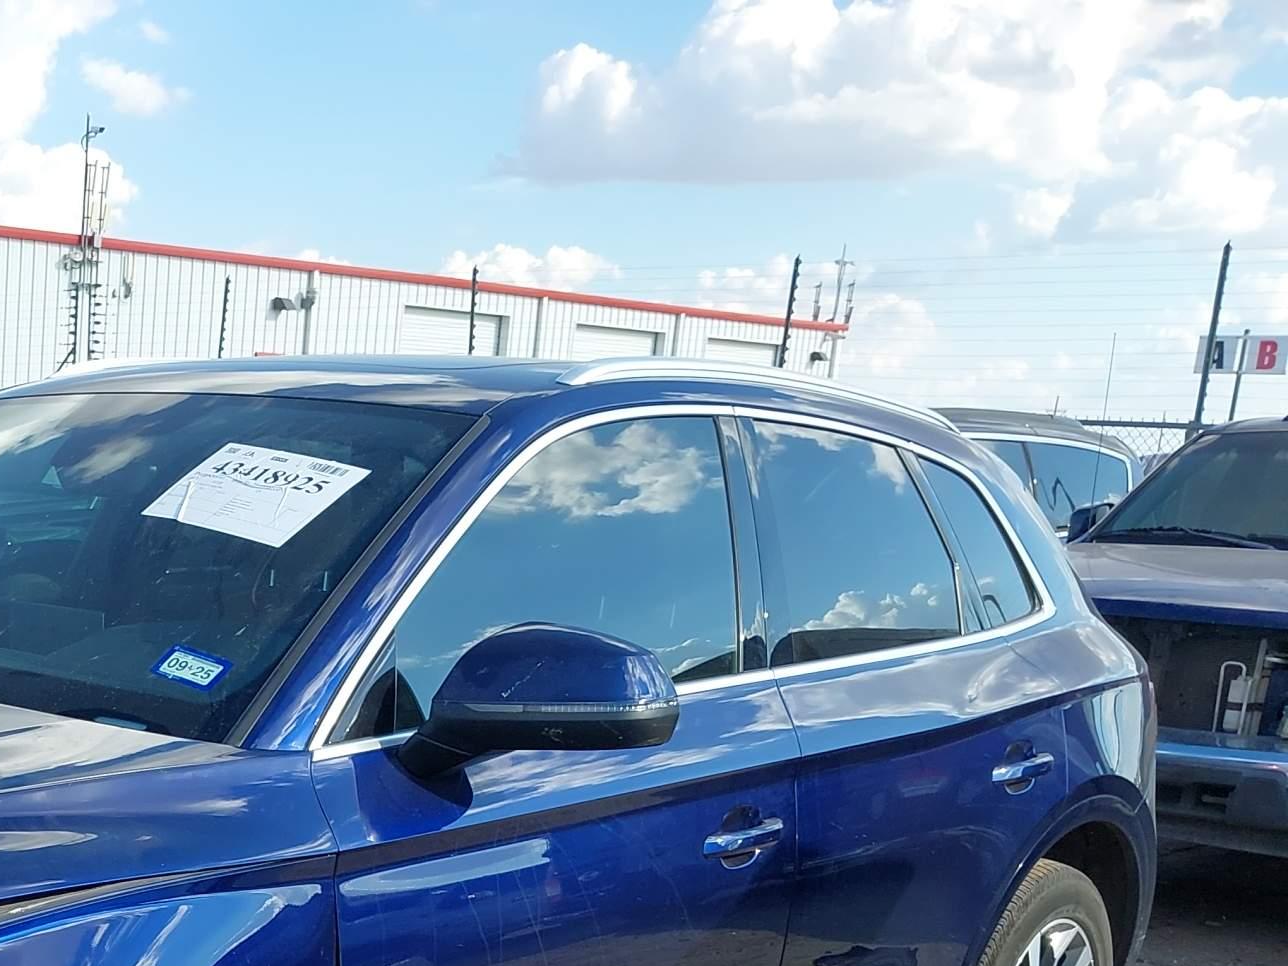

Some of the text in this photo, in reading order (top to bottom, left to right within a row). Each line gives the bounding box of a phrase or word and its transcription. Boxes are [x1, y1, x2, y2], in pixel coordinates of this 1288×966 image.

[1211, 340, 1278, 370] A B
[212, 460, 331, 495] 43418925
